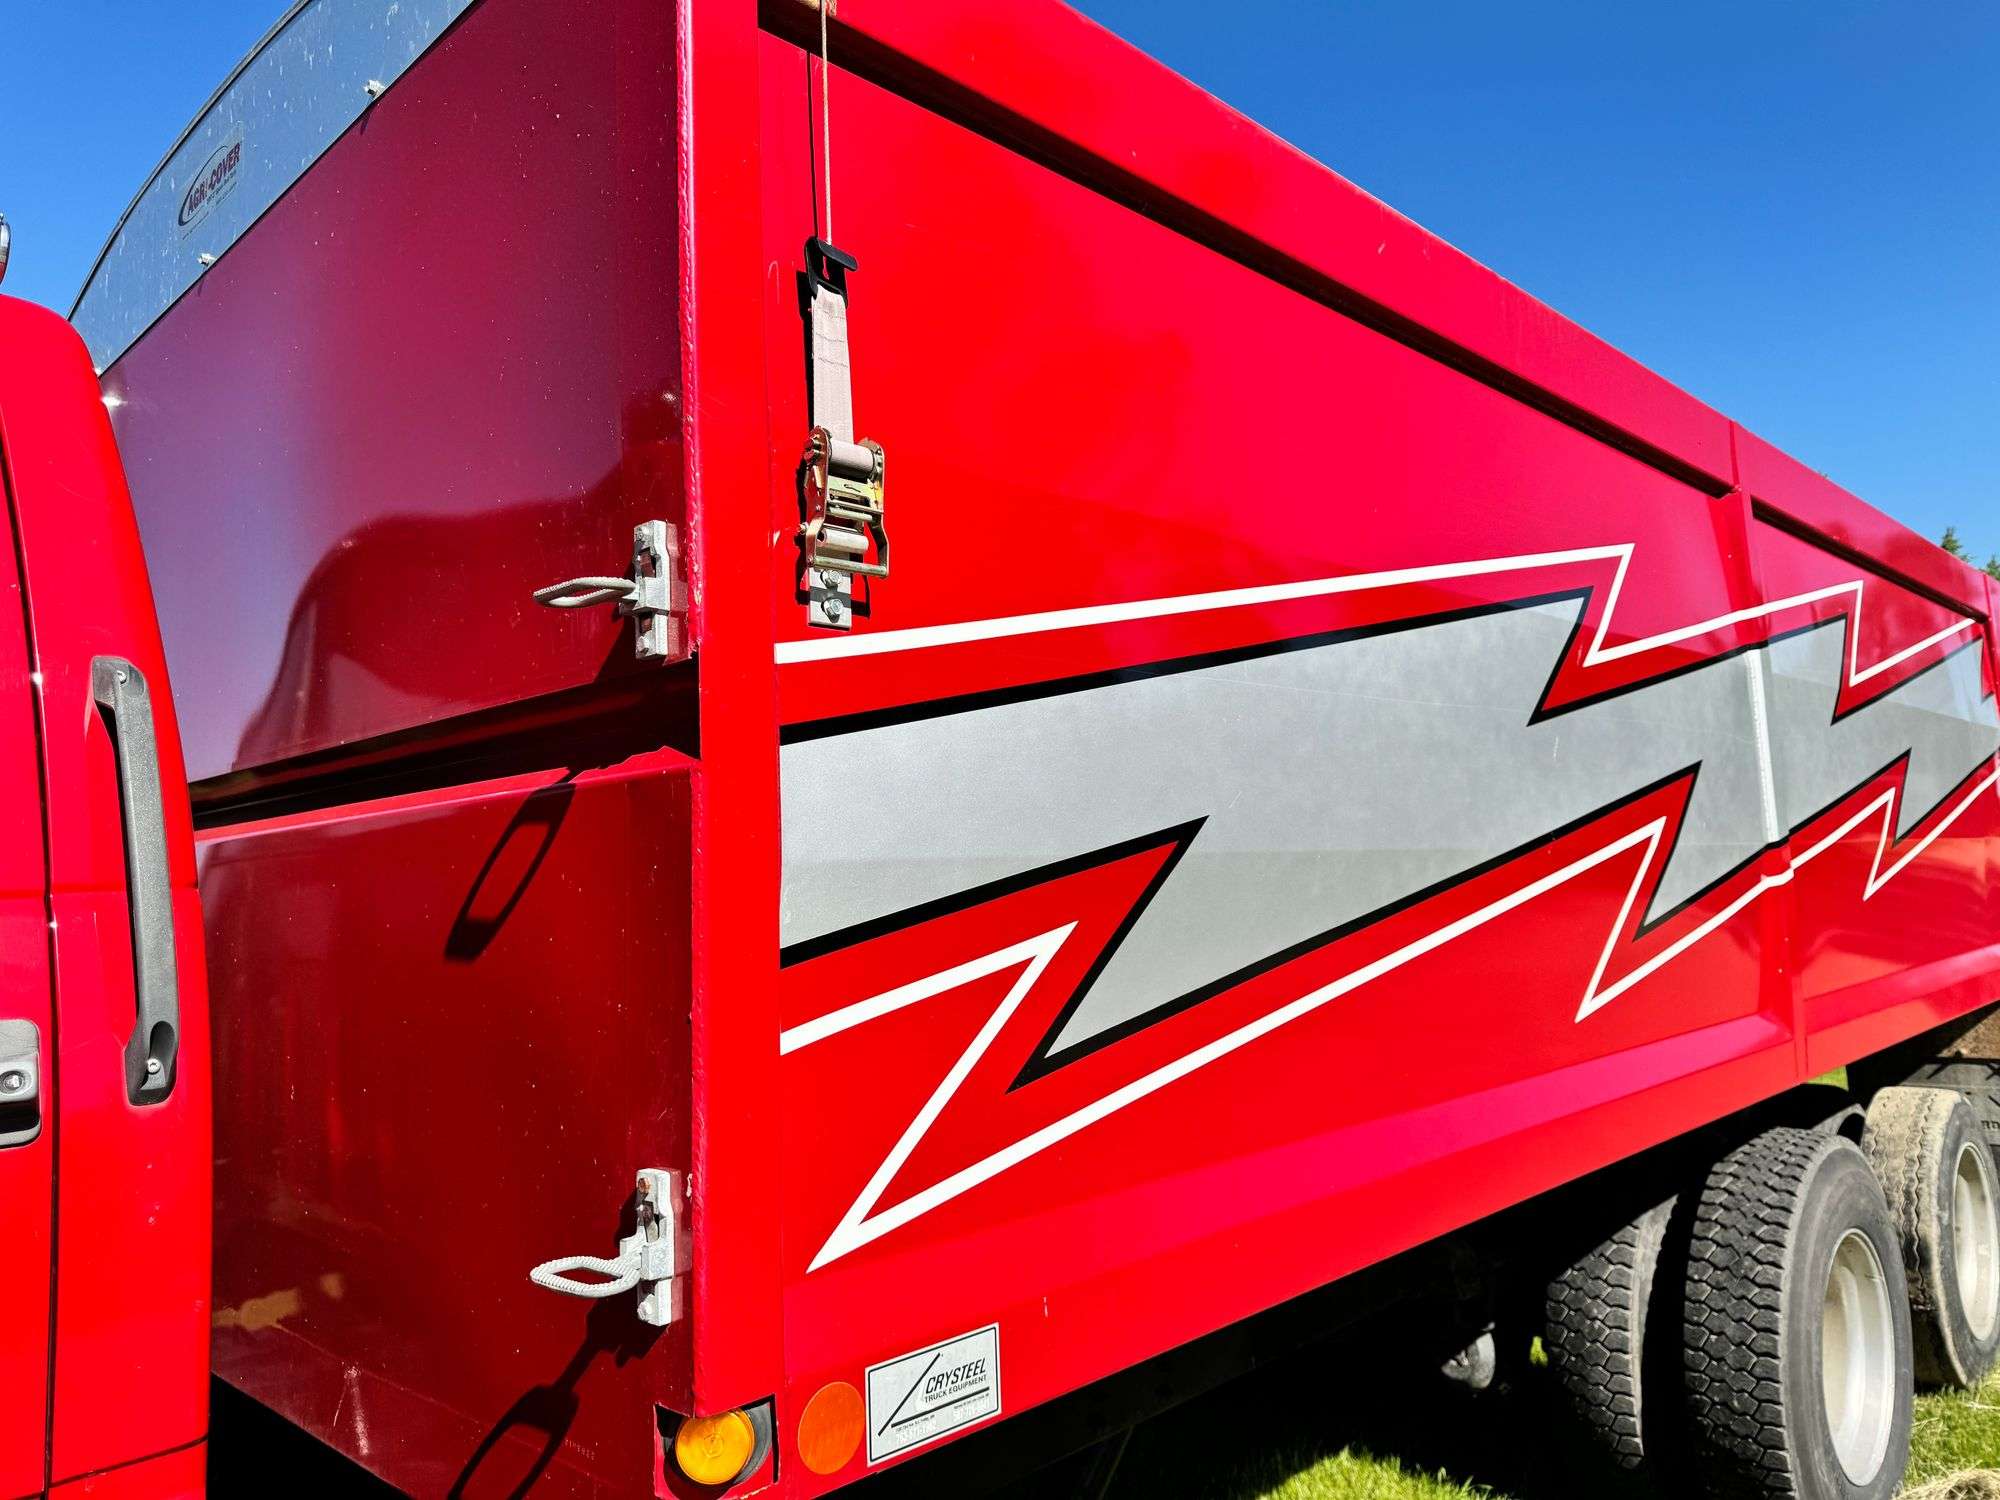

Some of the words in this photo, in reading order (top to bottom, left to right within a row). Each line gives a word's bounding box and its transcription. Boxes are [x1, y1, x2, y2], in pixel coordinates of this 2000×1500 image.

[924, 1387, 948, 1403] TRUCK
[948, 1374, 987, 1395] EQUIPMENT
[925, 1358, 986, 1394] CRYSTEEL
